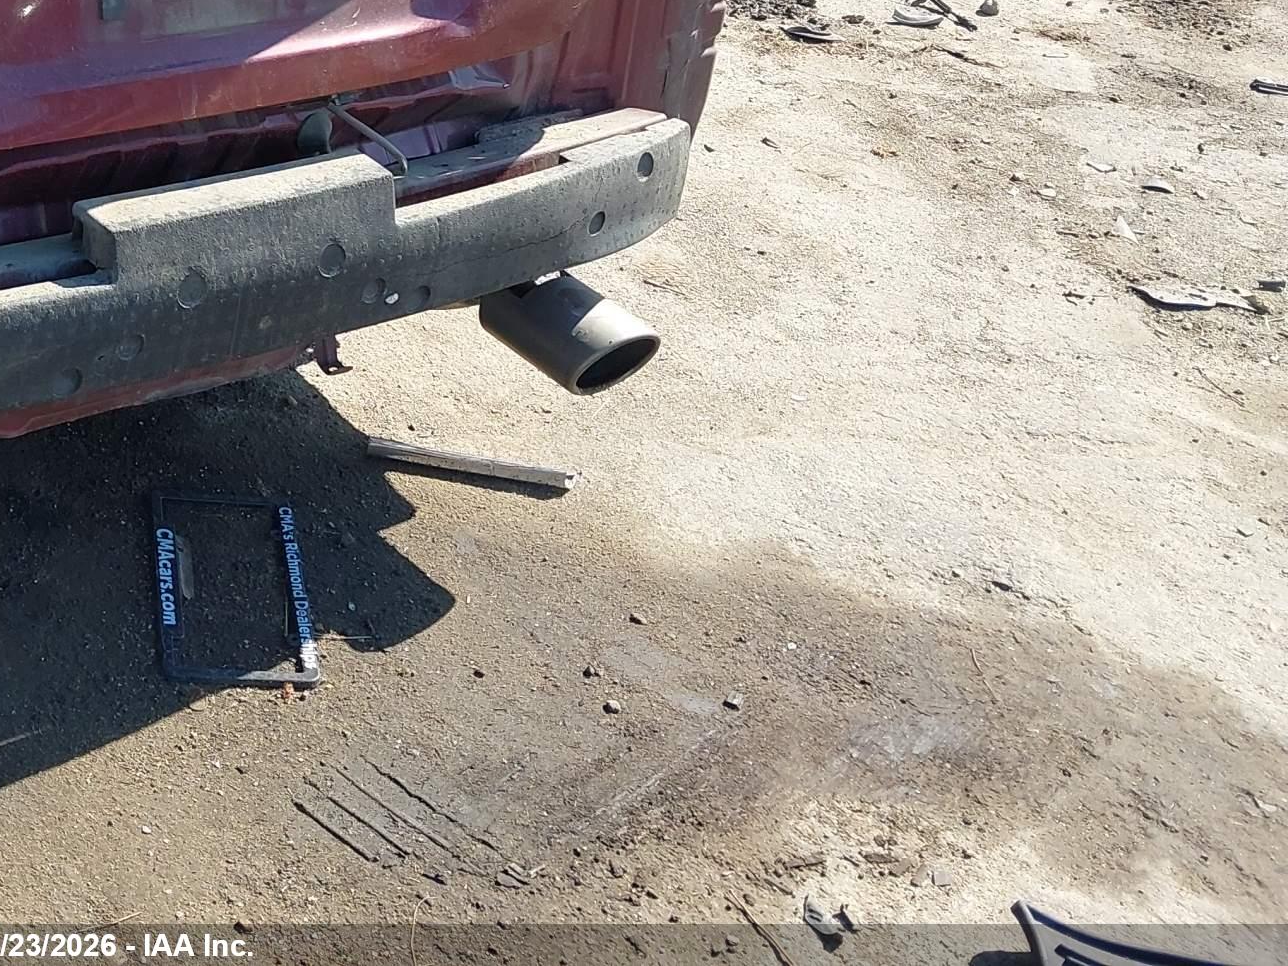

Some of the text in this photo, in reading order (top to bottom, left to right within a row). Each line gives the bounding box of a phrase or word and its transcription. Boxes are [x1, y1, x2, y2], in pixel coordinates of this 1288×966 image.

[155, 528, 177, 625] CMAcars.com
[278, 506, 318, 670] CMA's Richmond Dealerships
